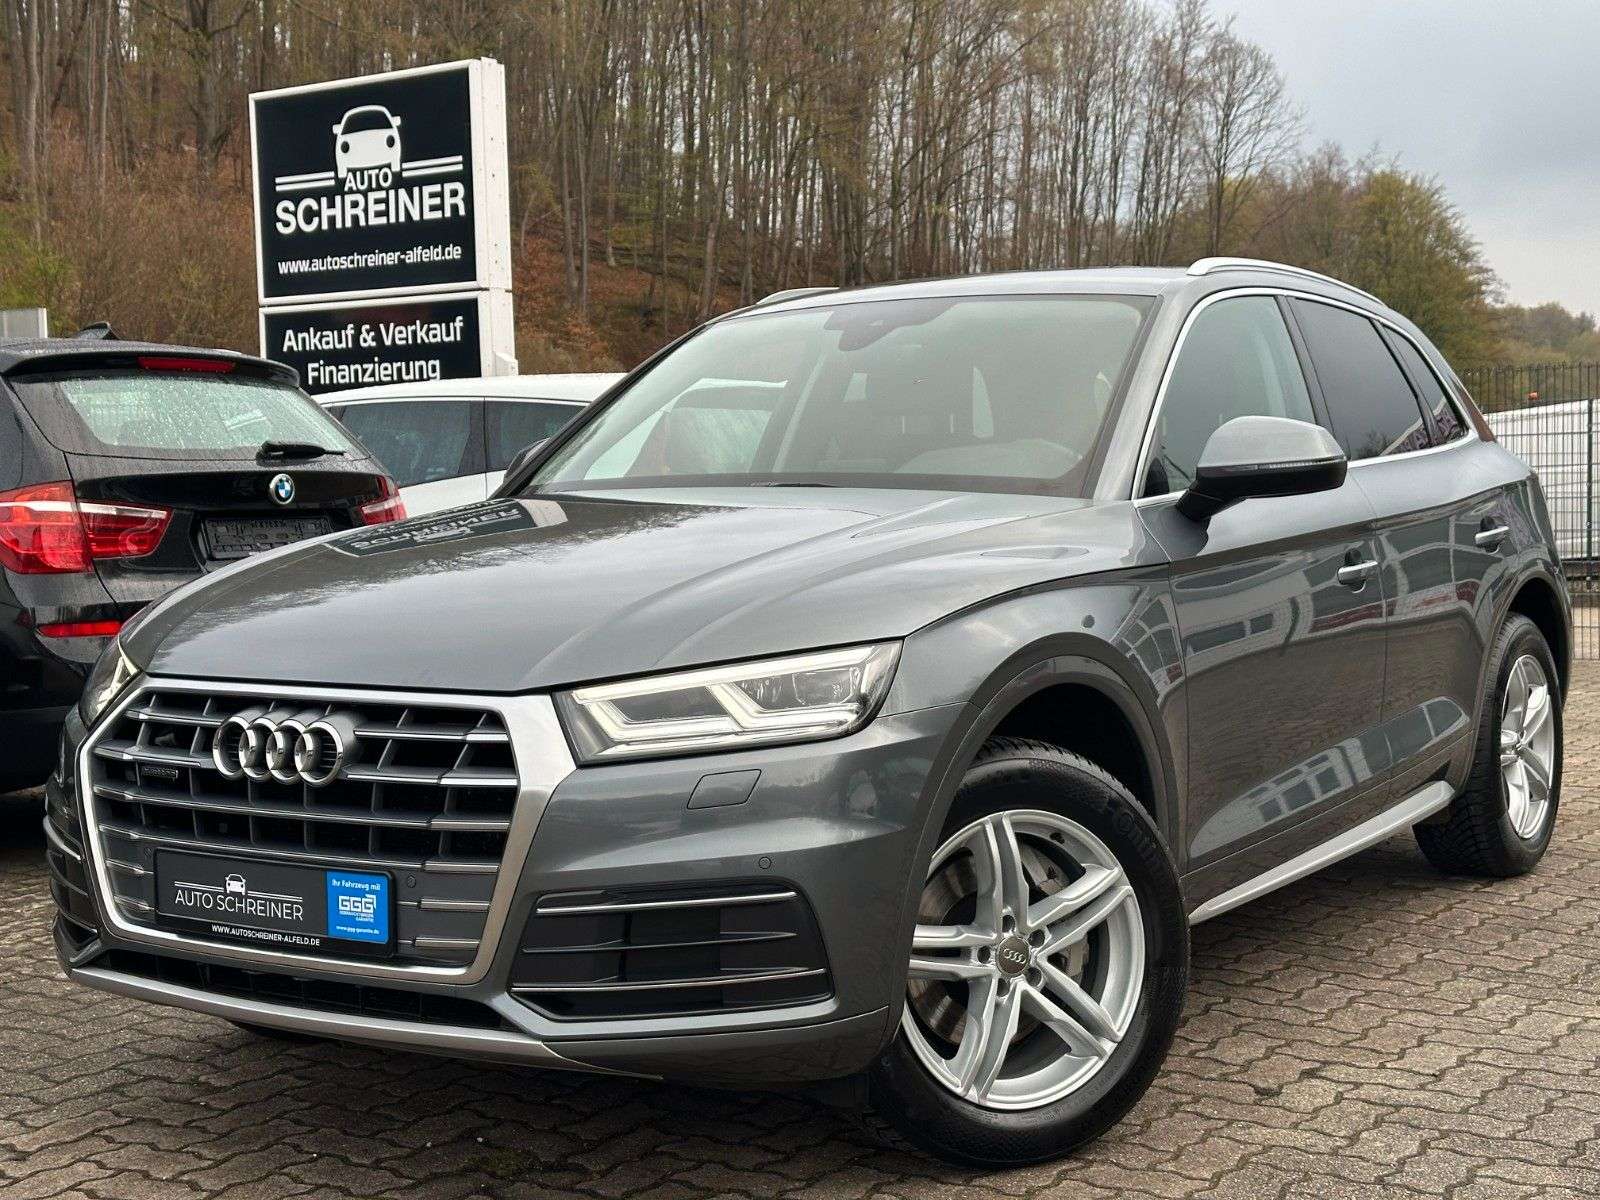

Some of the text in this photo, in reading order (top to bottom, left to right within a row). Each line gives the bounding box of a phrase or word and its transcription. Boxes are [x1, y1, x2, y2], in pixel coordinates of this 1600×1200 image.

[344, 167, 393, 192] AUTO
[275, 181, 466, 235] SCHREINER
[278, 243, 462, 275] www.autoschreiner-alfeld.de
[282, 316, 464, 352] Ankauf & Verkauf
[307, 357, 441, 386] Finanzierung
[342, 880, 370, 891] Fahrzeug
[175, 889, 304, 921] AUTO SCHREINER
[338, 894, 375, 913] GGG
[211, 924, 320, 947] WWW.AUTOSCHREINER-ALFELD.DE
